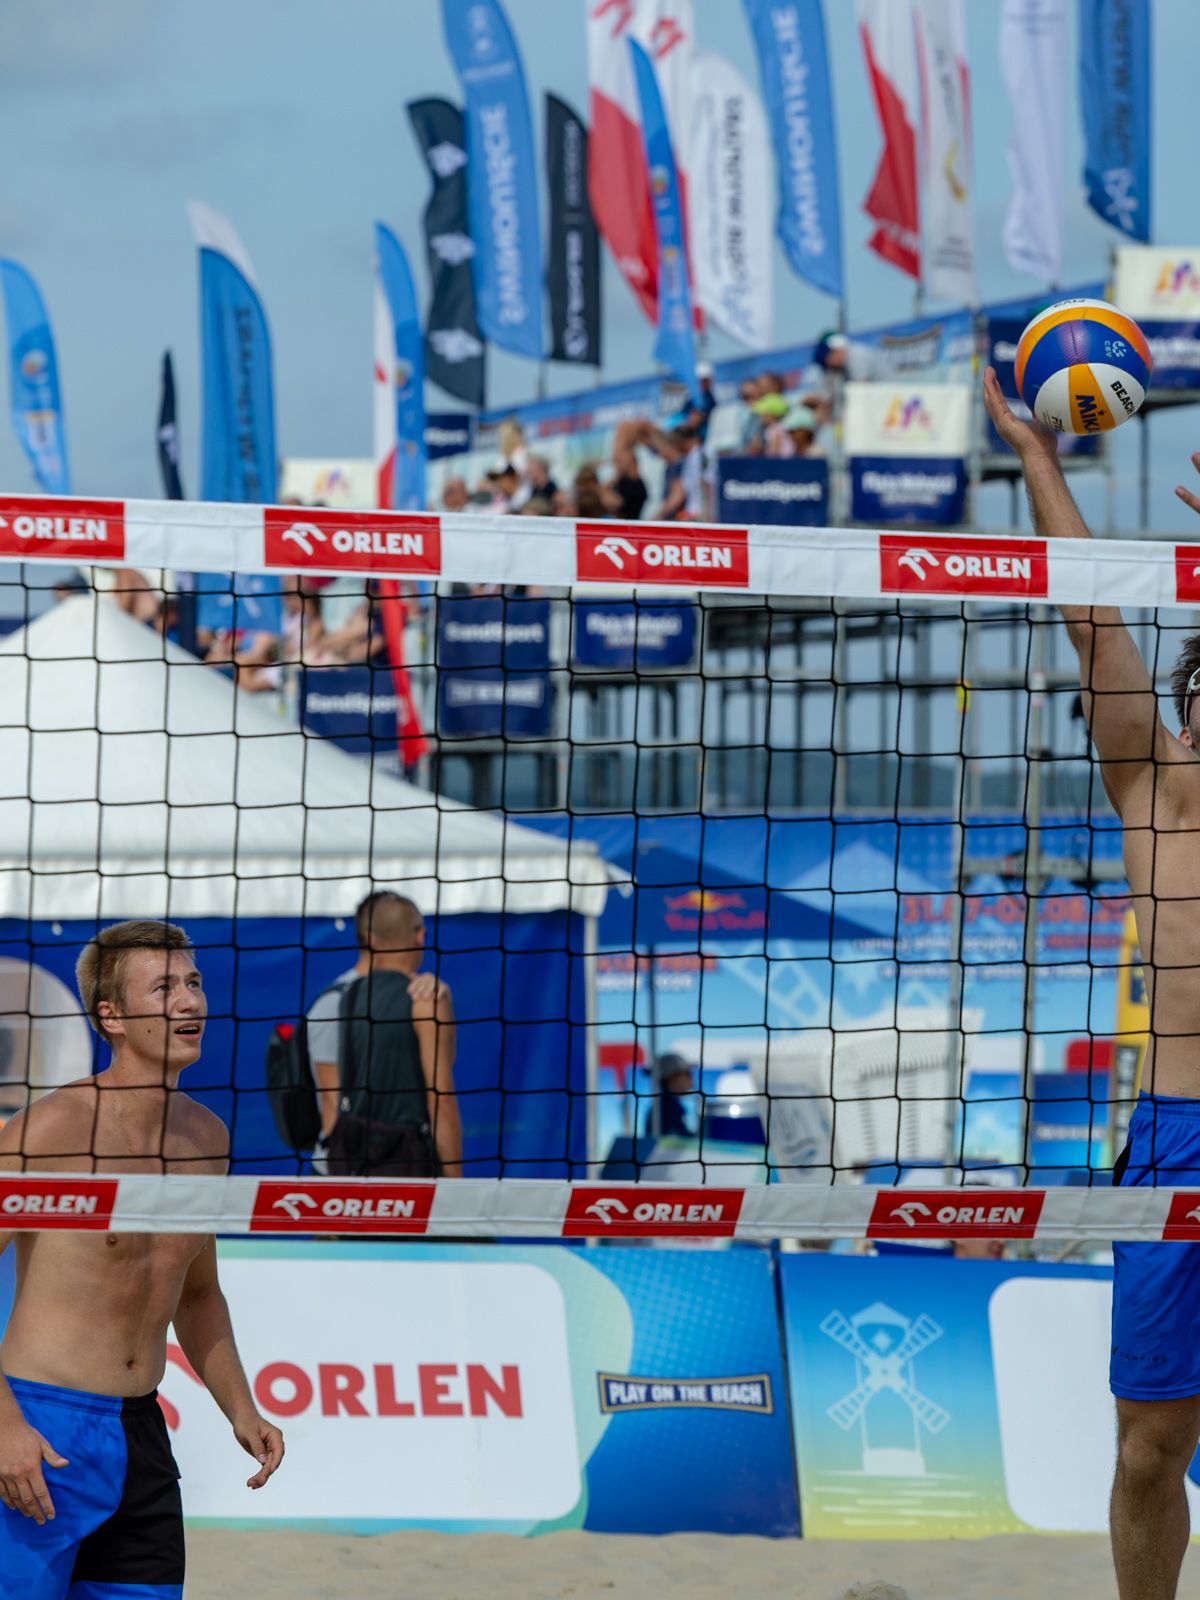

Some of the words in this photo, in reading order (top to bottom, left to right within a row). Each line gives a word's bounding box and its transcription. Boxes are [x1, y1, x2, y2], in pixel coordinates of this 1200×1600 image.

[14, 517, 107, 541] ORLEN
[332, 530, 424, 556] ORLEN
[642, 544, 732, 569] ORLEN
[944, 555, 1031, 579] ORLEN
[3, 1195, 97, 1213] ORLEN
[322, 1198, 414, 1218] ORLEN
[633, 1203, 724, 1222] ORLEN
[936, 1206, 1024, 1224] ORLEN
[254, 1361, 524, 1419] ORLEN
[608, 1382, 648, 1405] PLAY
[651, 1384, 675, 1402] ON
[678, 1384, 707, 1402] THE
[711, 1383, 763, 1406] BEACH
